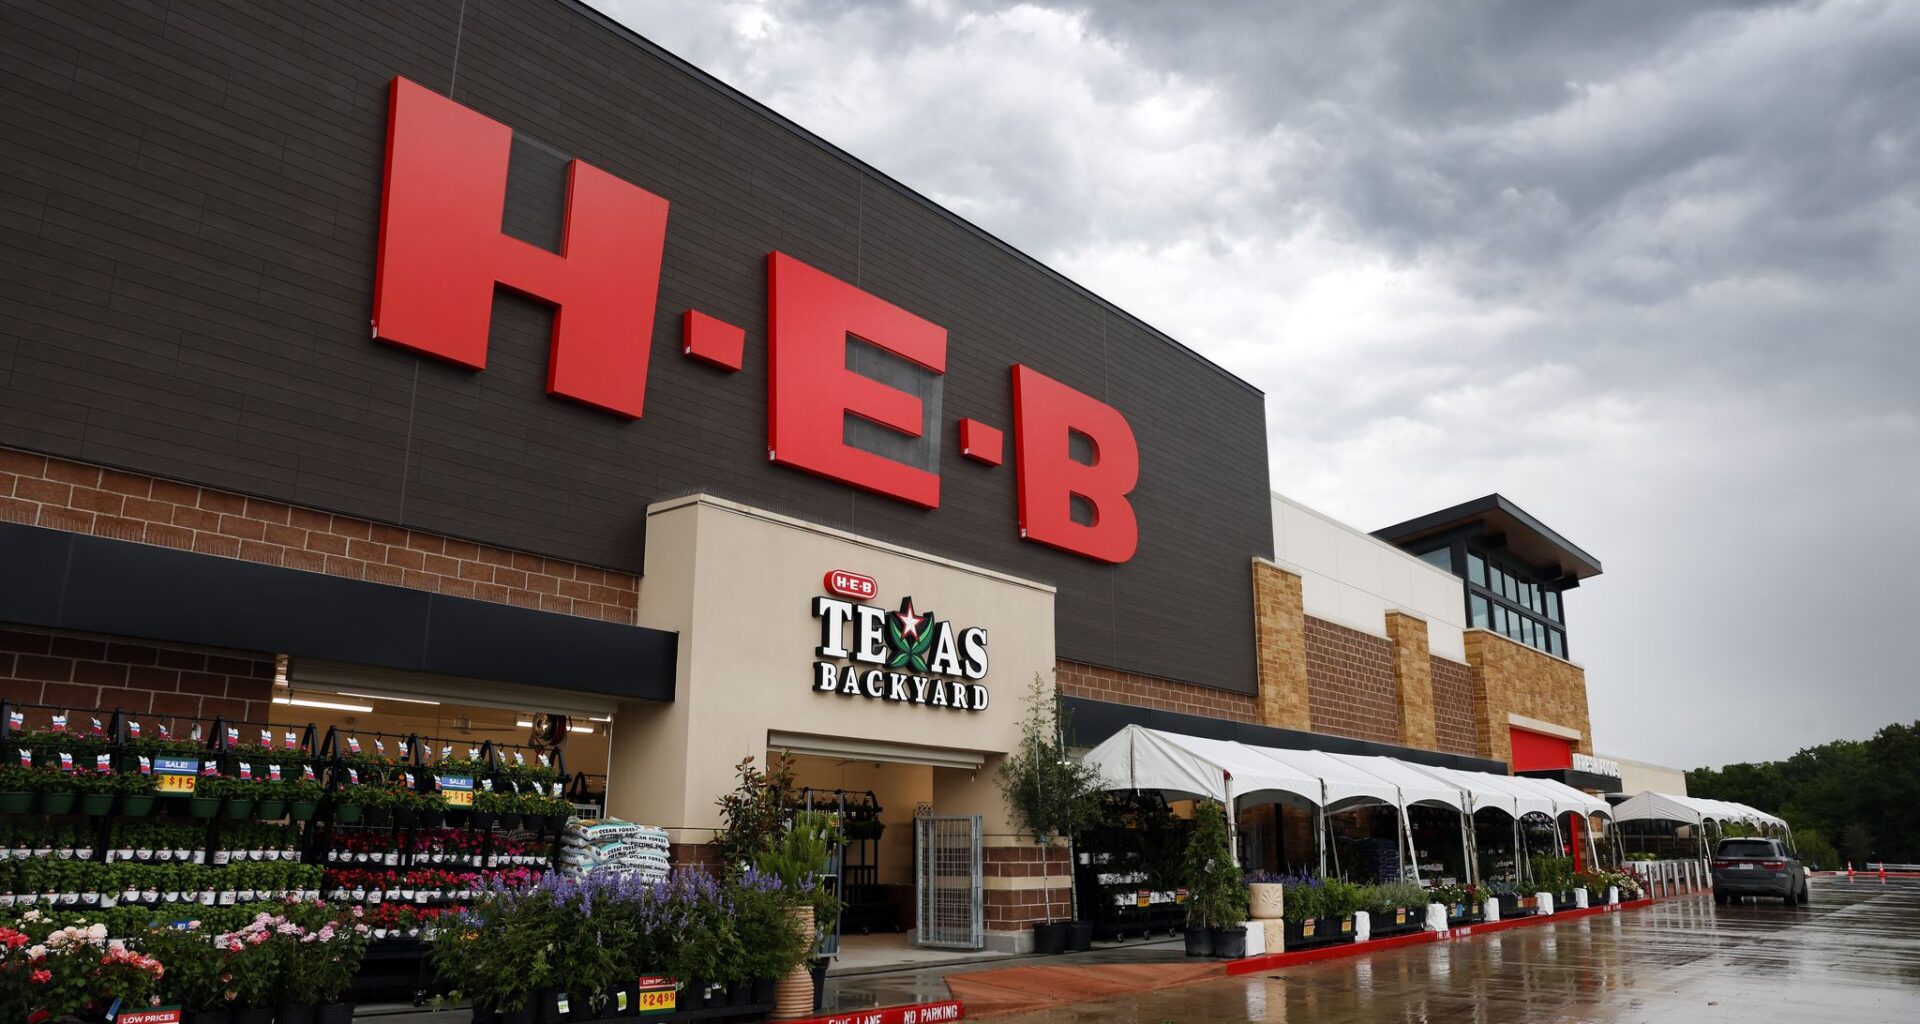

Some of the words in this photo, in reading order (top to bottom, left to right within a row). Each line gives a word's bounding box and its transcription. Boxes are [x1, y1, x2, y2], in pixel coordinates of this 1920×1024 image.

[372, 75, 1140, 563] H-E-B
[813, 596, 989, 680] TEXAS
[813, 661, 989, 711] BACKYARD
[123, 1016, 144, 1024] LOW
[144, 1014, 175, 1022] PRICES
[903, 1010, 917, 1024] NO
[920, 1005, 958, 1023] PARKING
